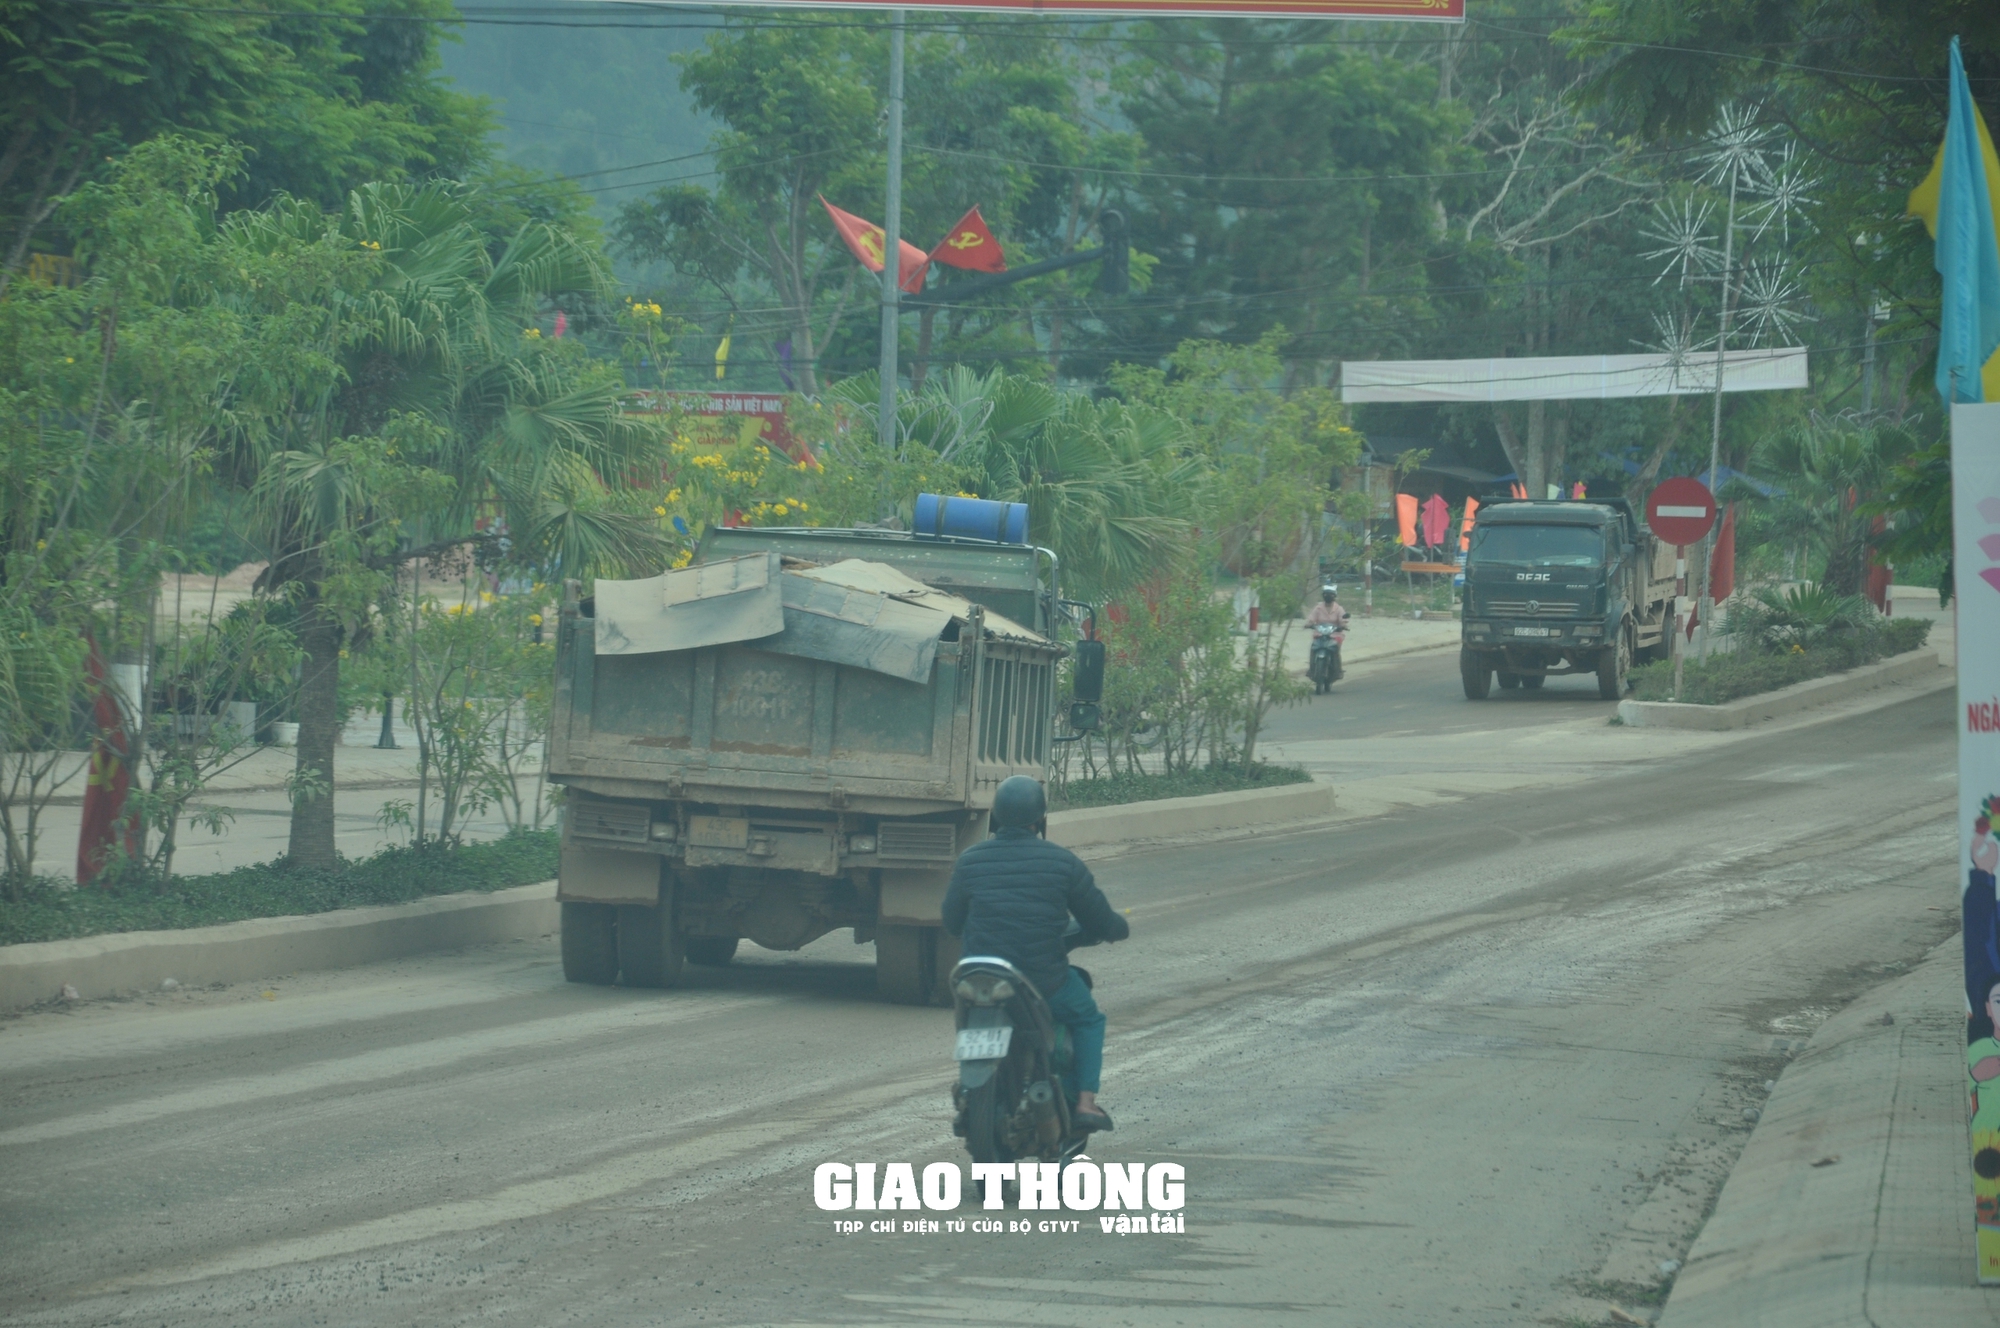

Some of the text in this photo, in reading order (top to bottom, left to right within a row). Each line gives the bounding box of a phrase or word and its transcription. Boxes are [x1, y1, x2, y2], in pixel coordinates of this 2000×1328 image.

[725, 395, 742, 412] SẢN
[743, 397, 761, 414] VIỆT
[707, 819, 731, 832] 43C
